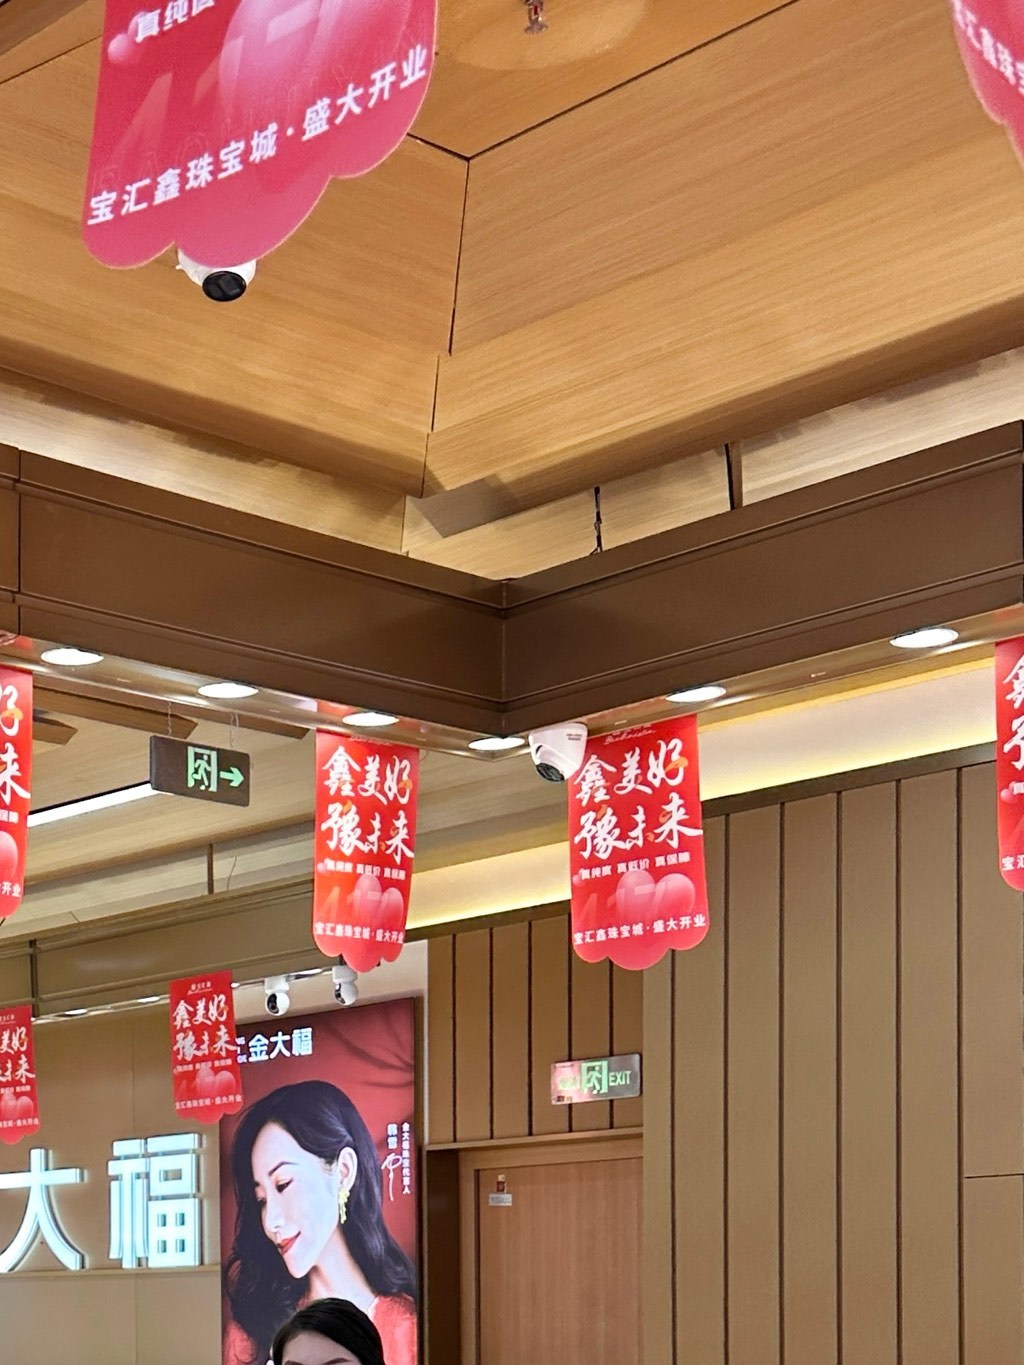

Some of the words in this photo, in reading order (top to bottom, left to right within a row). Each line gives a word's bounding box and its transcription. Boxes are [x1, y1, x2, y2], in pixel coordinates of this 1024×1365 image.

[87, 44, 428, 226] 宝汇鑫珠宝城·盛大开业
[322, 745, 413, 805] 鑫美好
[574, 737, 689, 807] 鑫美好
[320, 801, 414, 865] 豫未来
[574, 792, 703, 860] 豫未来
[574, 913, 706, 945] 宝汇鑫珠宝城·盛大开业
[173, 994, 228, 1030] 鑫美好
[248, 1027, 313, 1062] 金大福
[609, 1070, 632, 1087] EXIT
